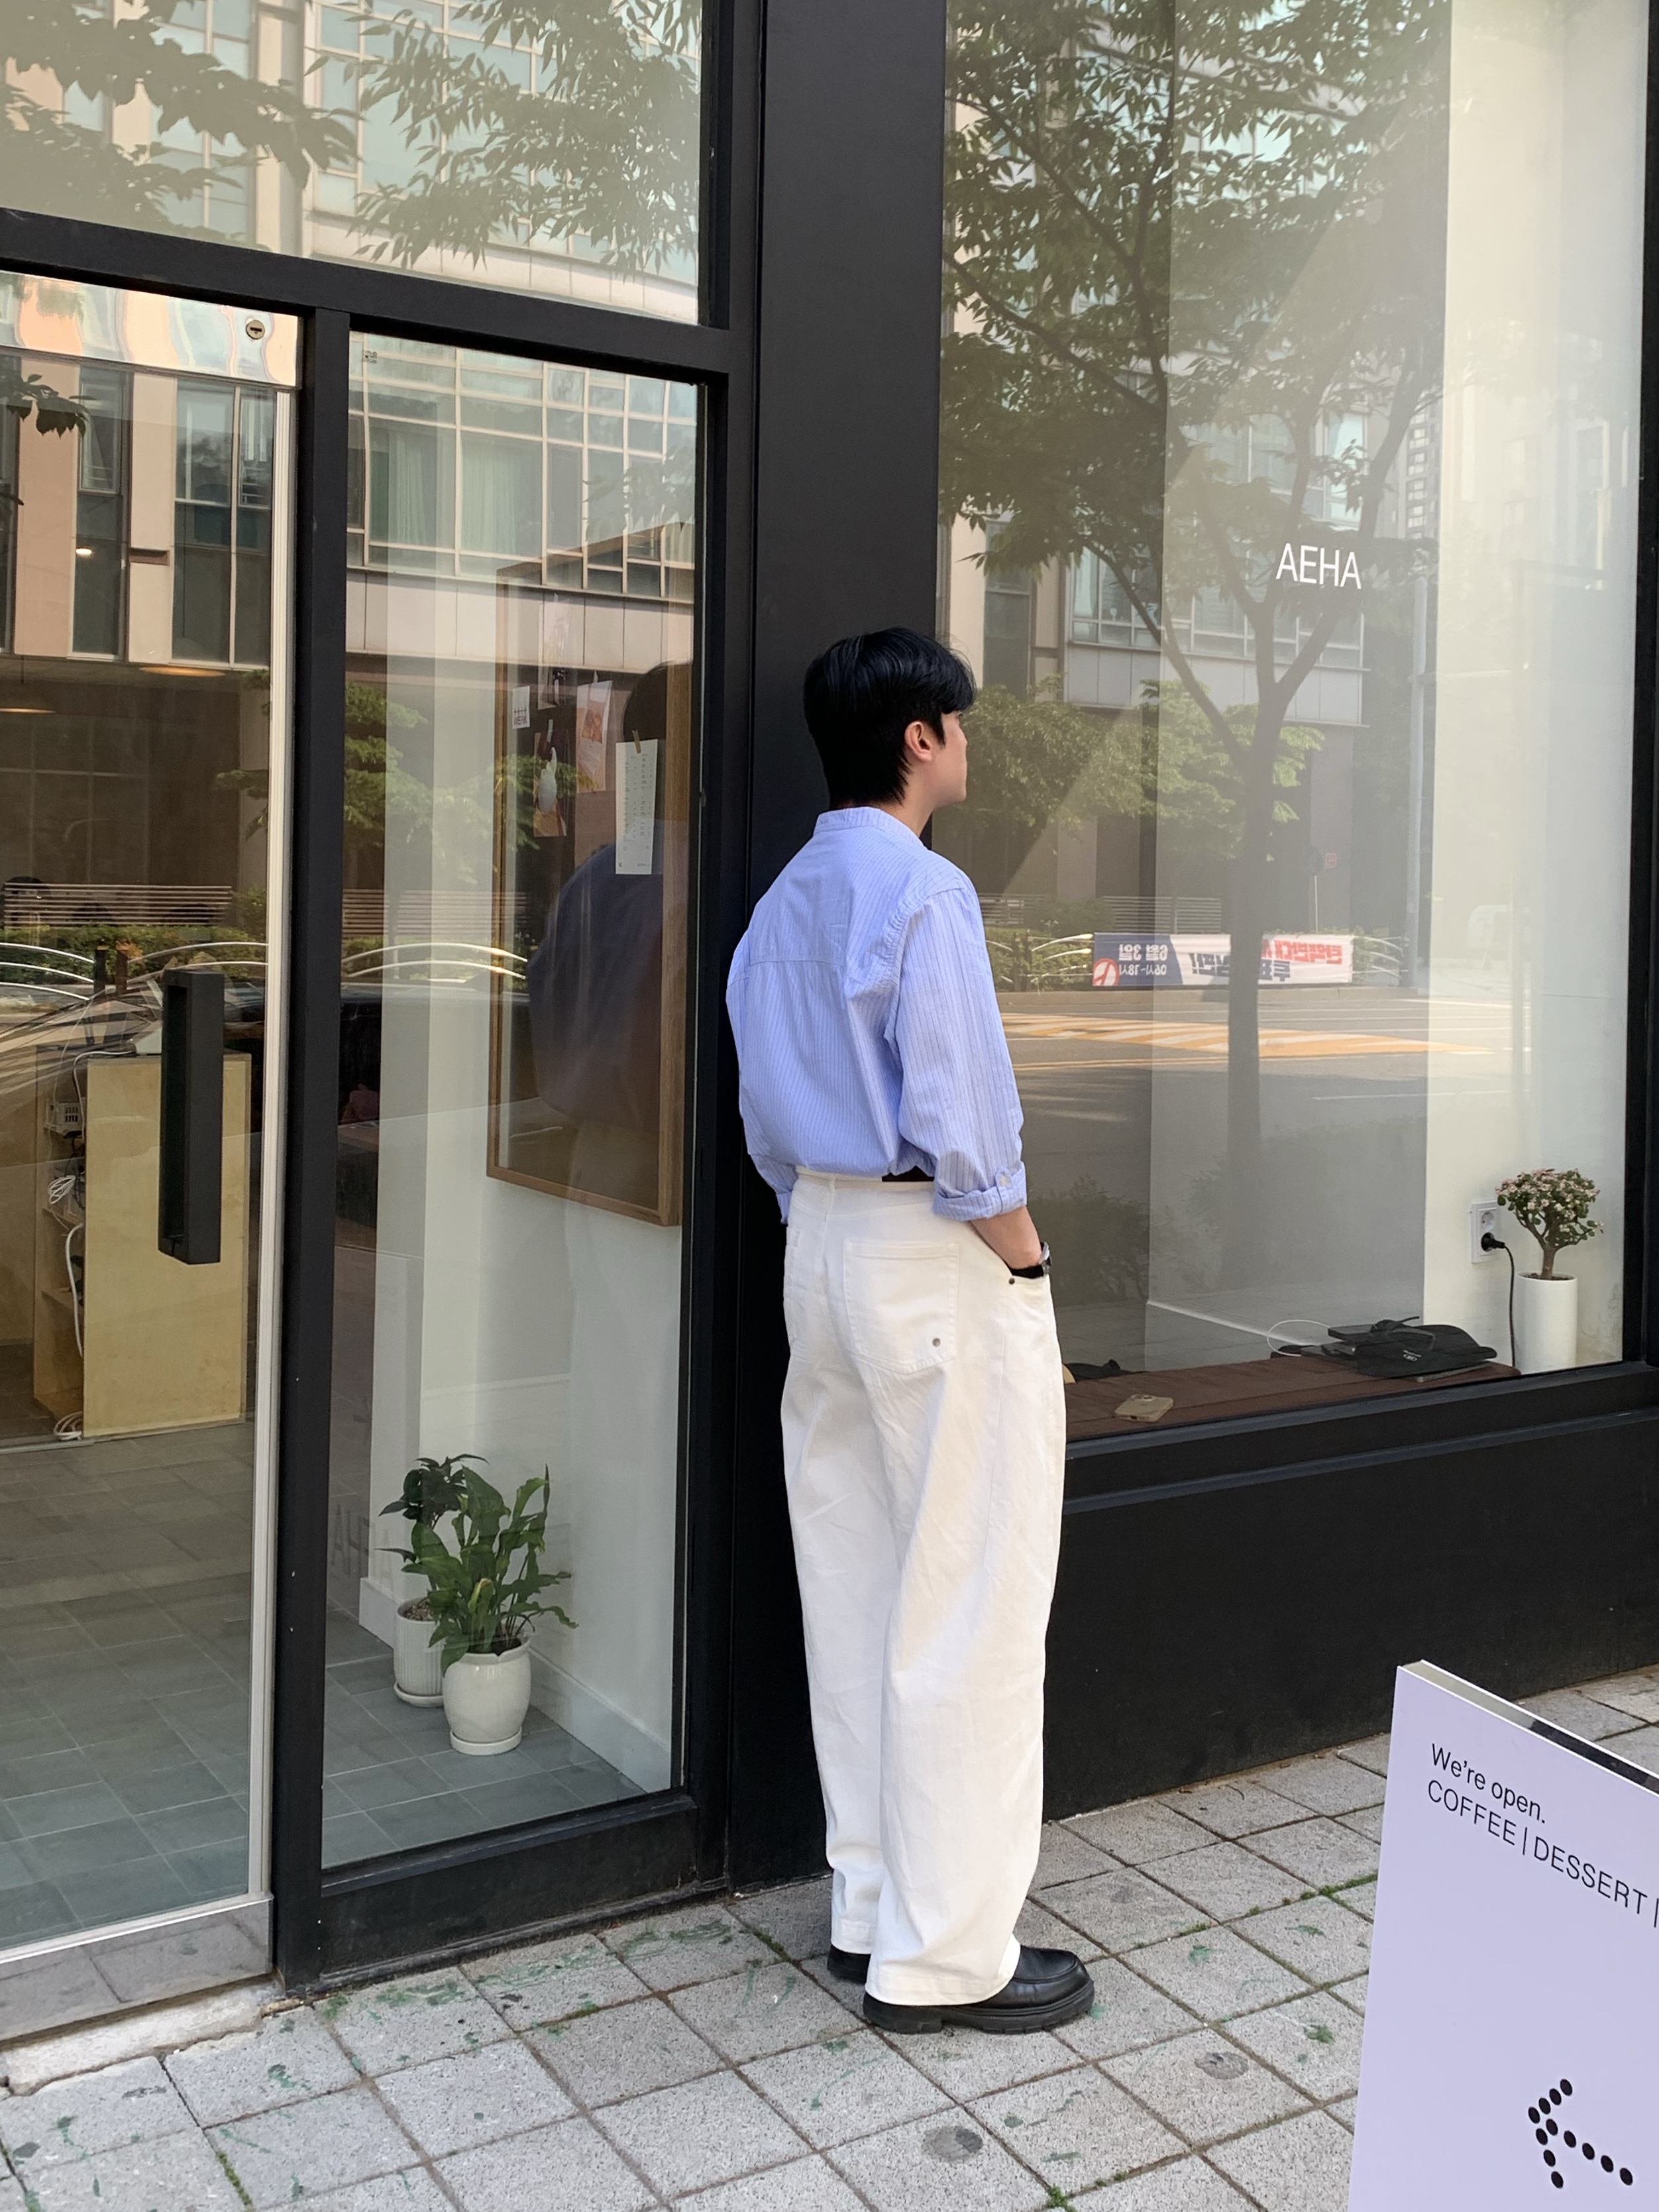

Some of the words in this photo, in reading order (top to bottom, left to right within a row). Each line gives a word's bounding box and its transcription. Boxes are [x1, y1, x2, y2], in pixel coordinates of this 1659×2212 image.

[1275, 542, 1362, 589] AEHA
[1432, 1743, 1486, 1791] We're
[1491, 1781, 1546, 1824] open.
[1428, 1779, 1517, 1846] COFFEE
[1534, 1836, 1648, 1914] DESSERT
